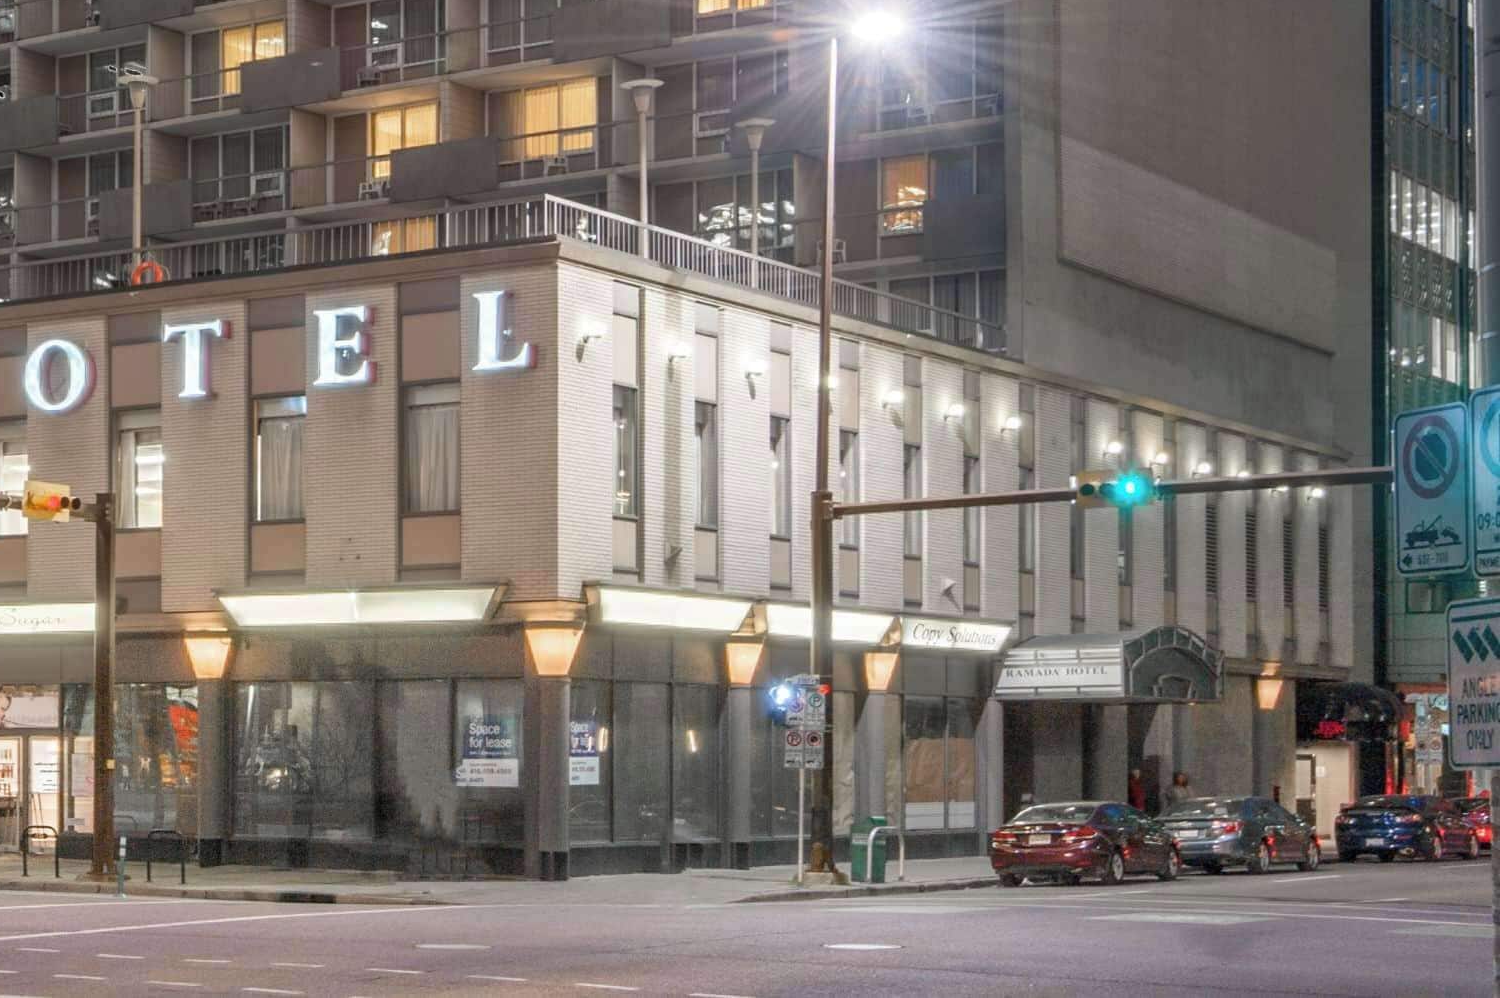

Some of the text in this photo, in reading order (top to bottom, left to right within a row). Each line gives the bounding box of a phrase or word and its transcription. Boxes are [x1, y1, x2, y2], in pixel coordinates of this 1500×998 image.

[912, 623, 998, 646] Copy Solutions
[1005, 666, 1108, 679] RAMADA HOTEL
[1461, 676, 1499, 699] ANGLE
[469, 723, 501, 736] Space
[469, 737, 512, 748] for lease
[1466, 729, 1495, 750] ONLY
